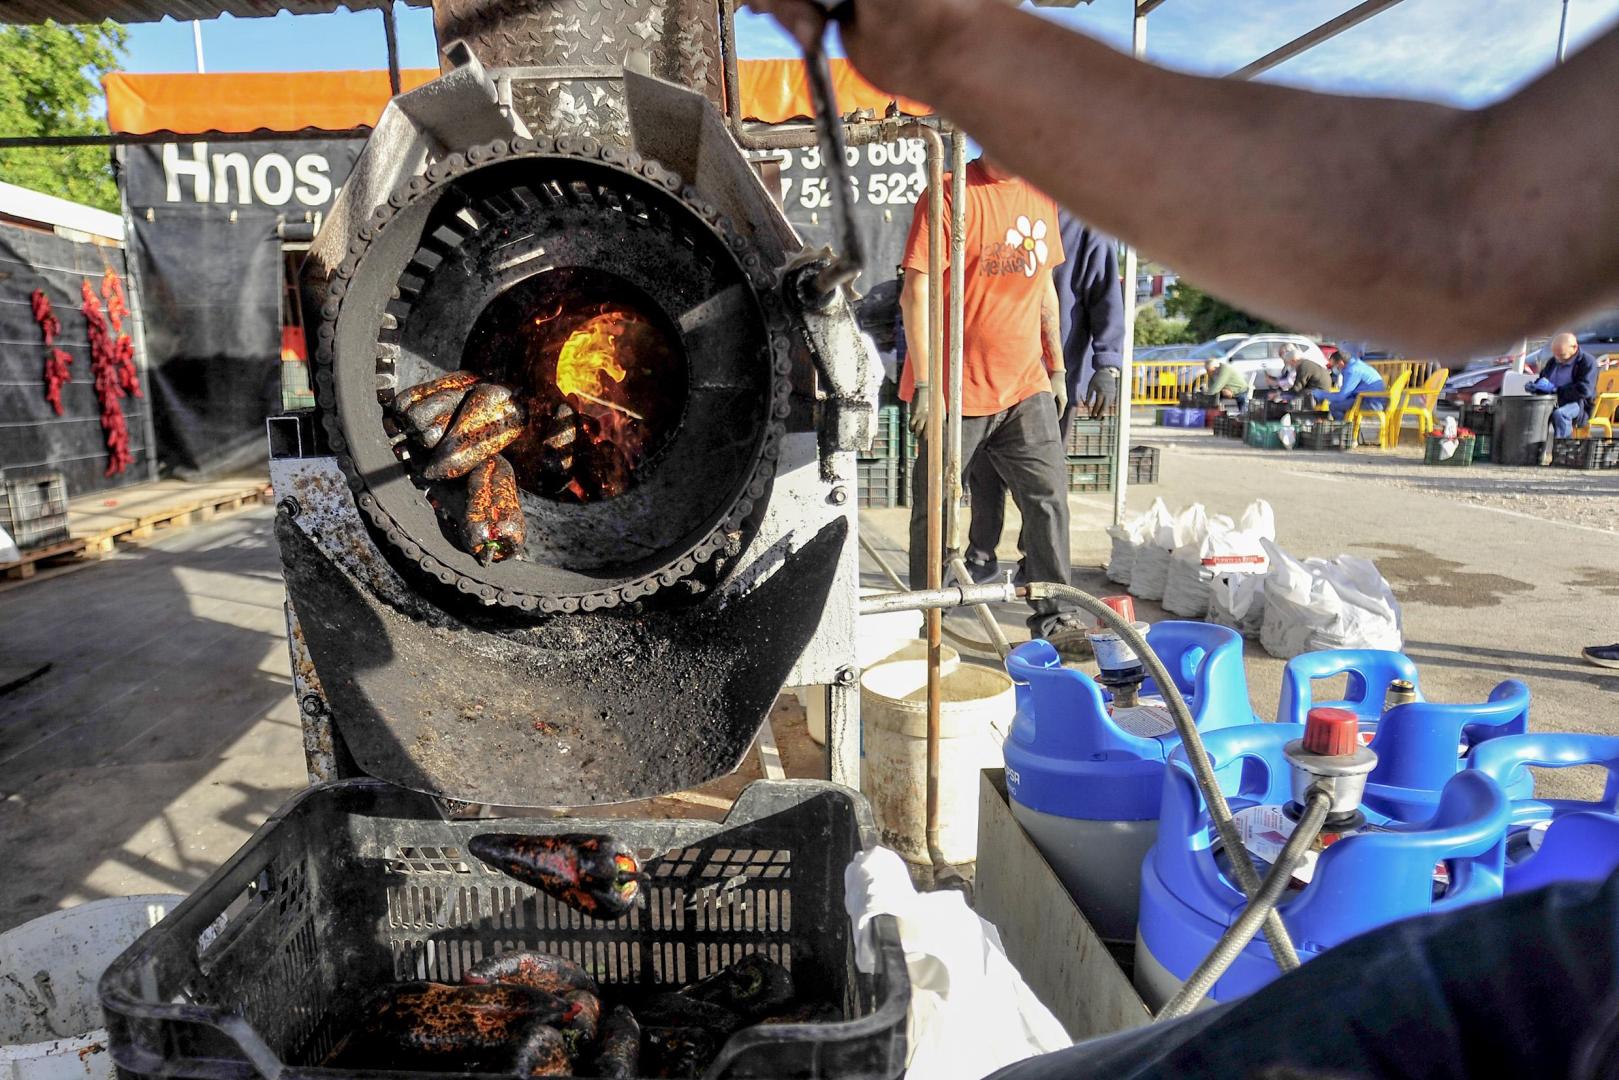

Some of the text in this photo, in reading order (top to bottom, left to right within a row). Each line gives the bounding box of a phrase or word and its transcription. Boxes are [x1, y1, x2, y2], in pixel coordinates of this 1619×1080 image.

[801, 146, 860, 170] 36
[867, 137, 926, 167] 608
[163, 142, 341, 206] Hnos
[867, 172, 927, 205] 523
